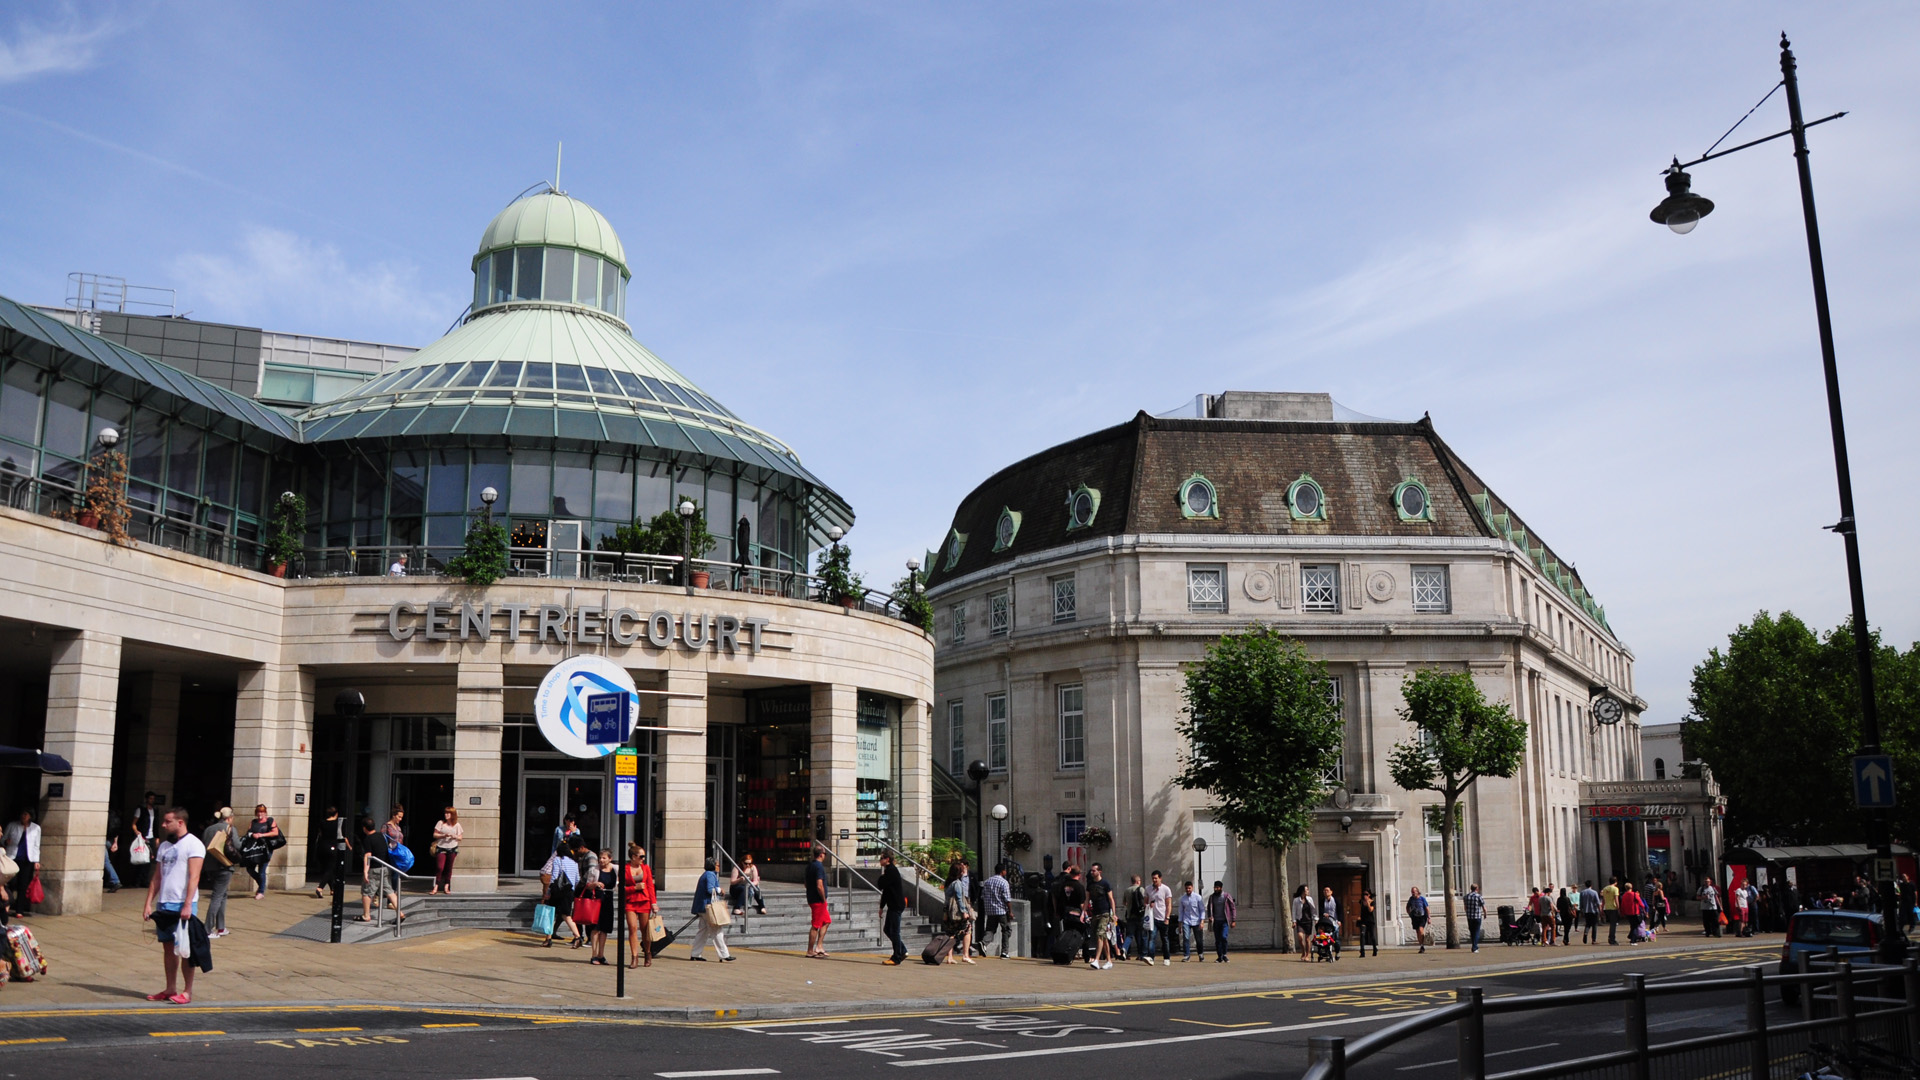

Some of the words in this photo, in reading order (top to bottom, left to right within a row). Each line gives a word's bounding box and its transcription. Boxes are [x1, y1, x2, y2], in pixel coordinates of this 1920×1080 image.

[389, 600, 770, 654] CENTRECOURT
[543, 689, 550, 698] to
[547, 672, 561, 689] shop
[589, 733, 600, 741] taxi
[856, 736, 878, 751] hittard
[1587, 804, 1641, 817] TESCO
[1644, 803, 1687, 816] Metro
[927, 1014, 1124, 1038] BUS
[253, 1035, 410, 1049] TAXIS
[730, 1018, 1009, 1057] LANE
